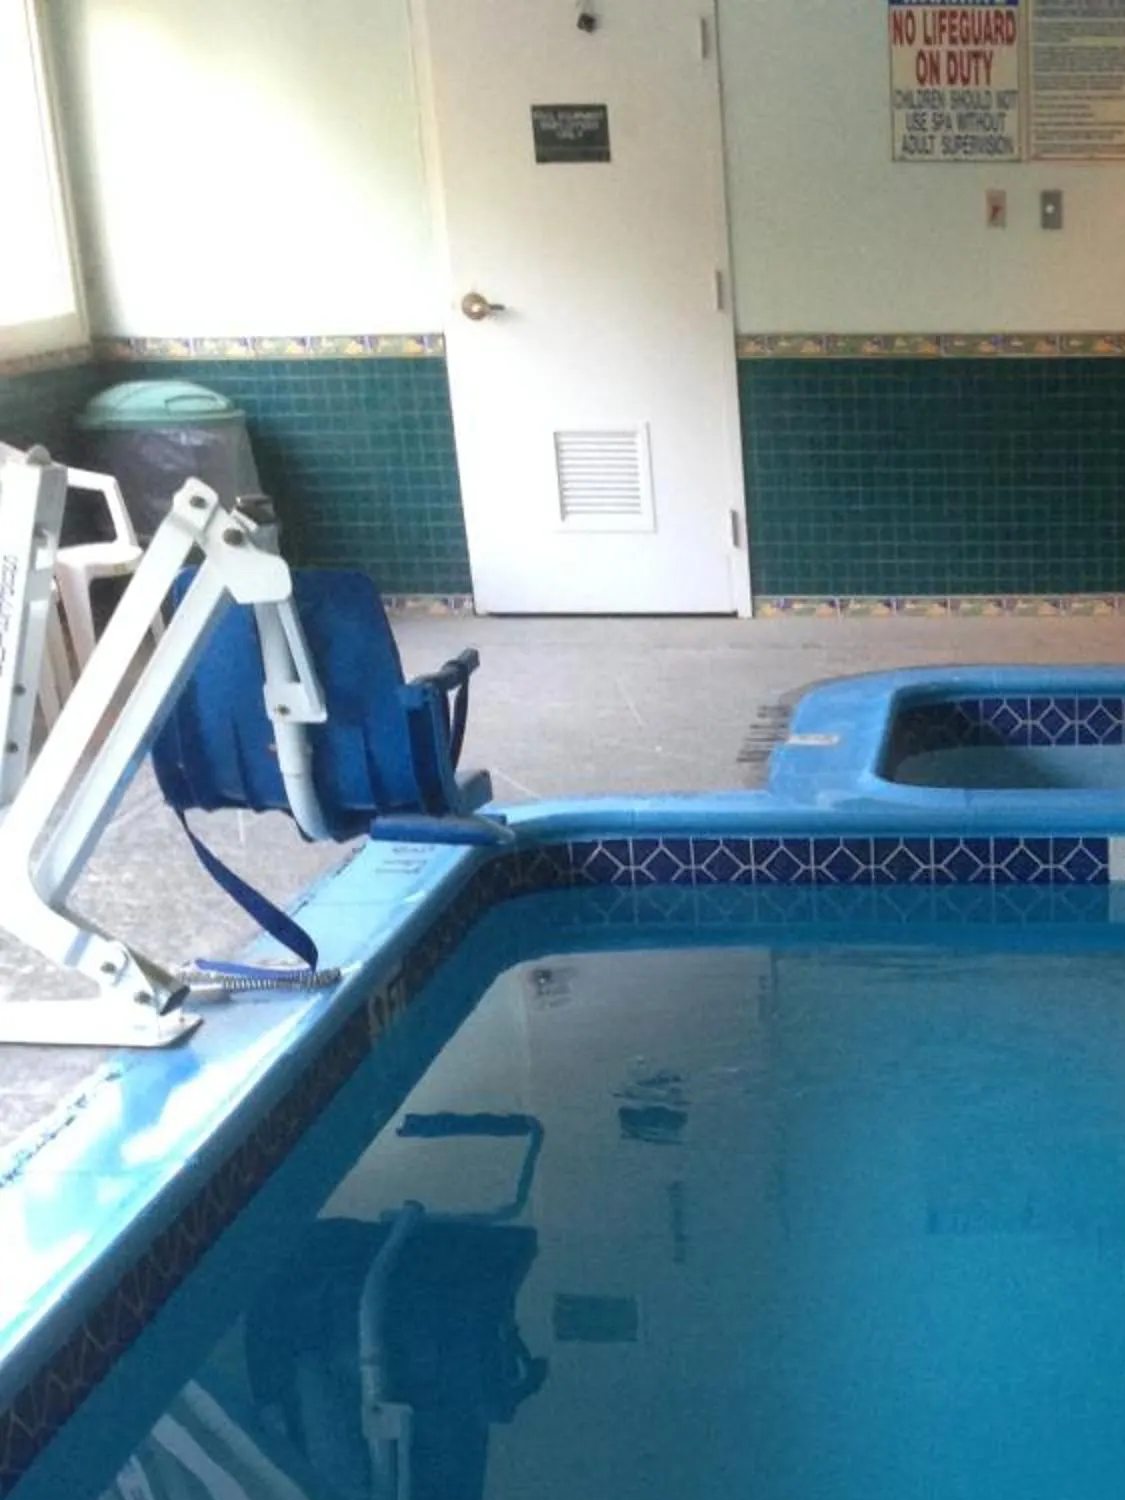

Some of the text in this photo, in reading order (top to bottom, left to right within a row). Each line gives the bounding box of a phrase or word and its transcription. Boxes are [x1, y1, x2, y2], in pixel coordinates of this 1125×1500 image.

[892, 9, 916, 45] NO
[922, 9, 1016, 45] LIFEGUARD
[916, 50, 941, 86] ON
[946, 50, 993, 86] DUTY
[905, 112, 927, 131] USE
[957, 112, 1006, 131] WITHOUT
[901, 135, 936, 154] ADULT
